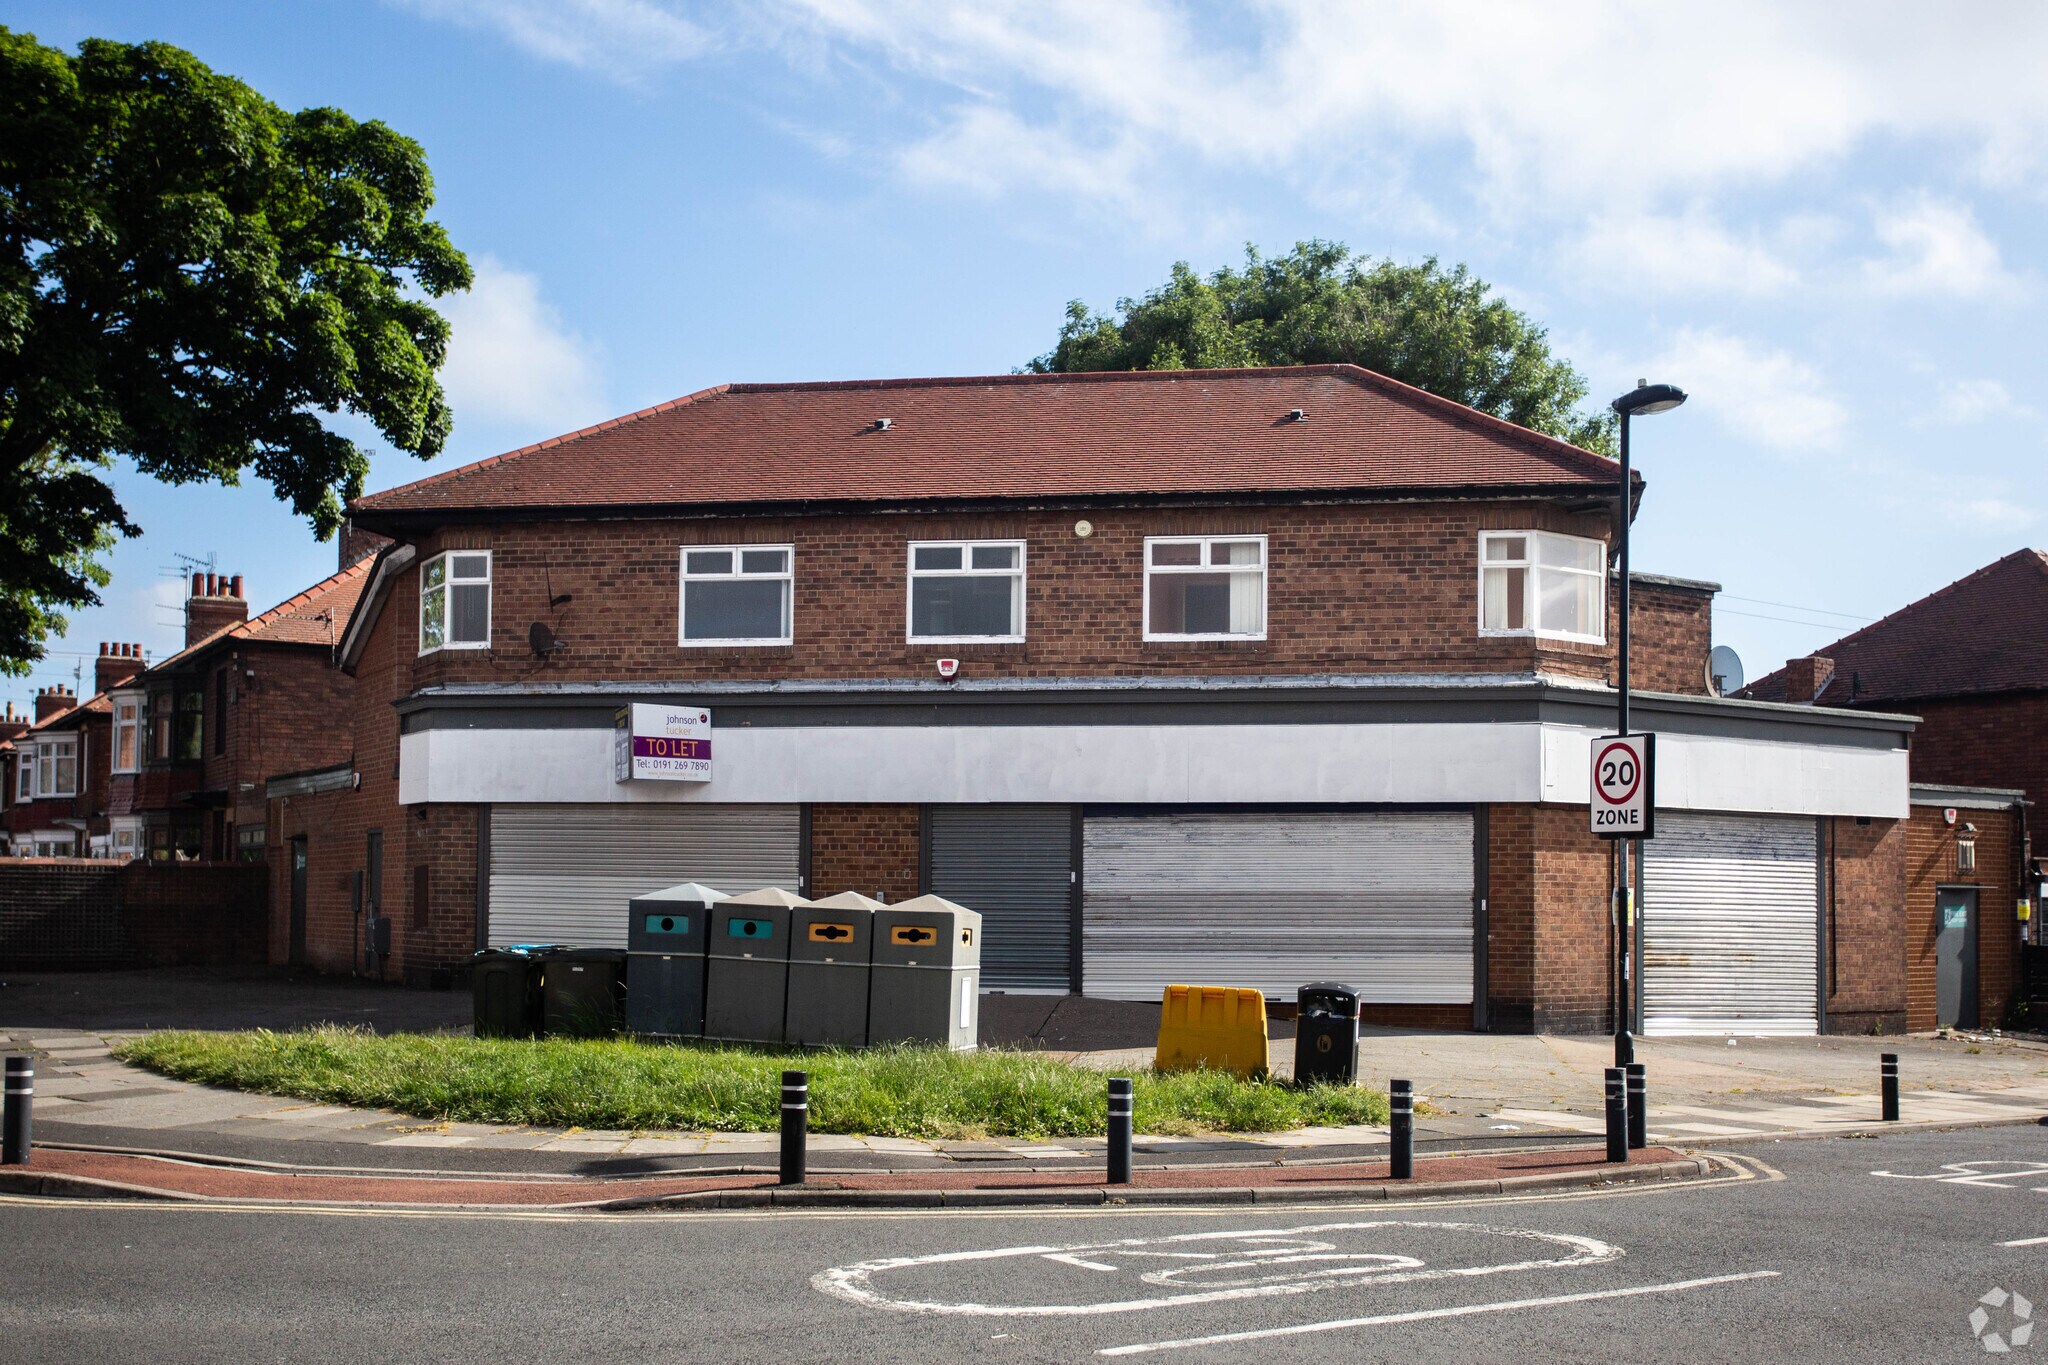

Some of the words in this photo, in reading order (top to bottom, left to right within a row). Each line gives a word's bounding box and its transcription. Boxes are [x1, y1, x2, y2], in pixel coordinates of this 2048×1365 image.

[666, 714, 697, 725] johnson
[666, 726, 692, 736] tucker
[646, 738, 667, 756] TO
[672, 740, 698, 757] LET
[636, 759, 651, 769] Tel:
[653, 760, 671, 769] 0191
[674, 761, 688, 770] 269
[691, 761, 709, 771] 7890
[1602, 761, 1634, 786] 20
[1596, 809, 1639, 825] ZONE
